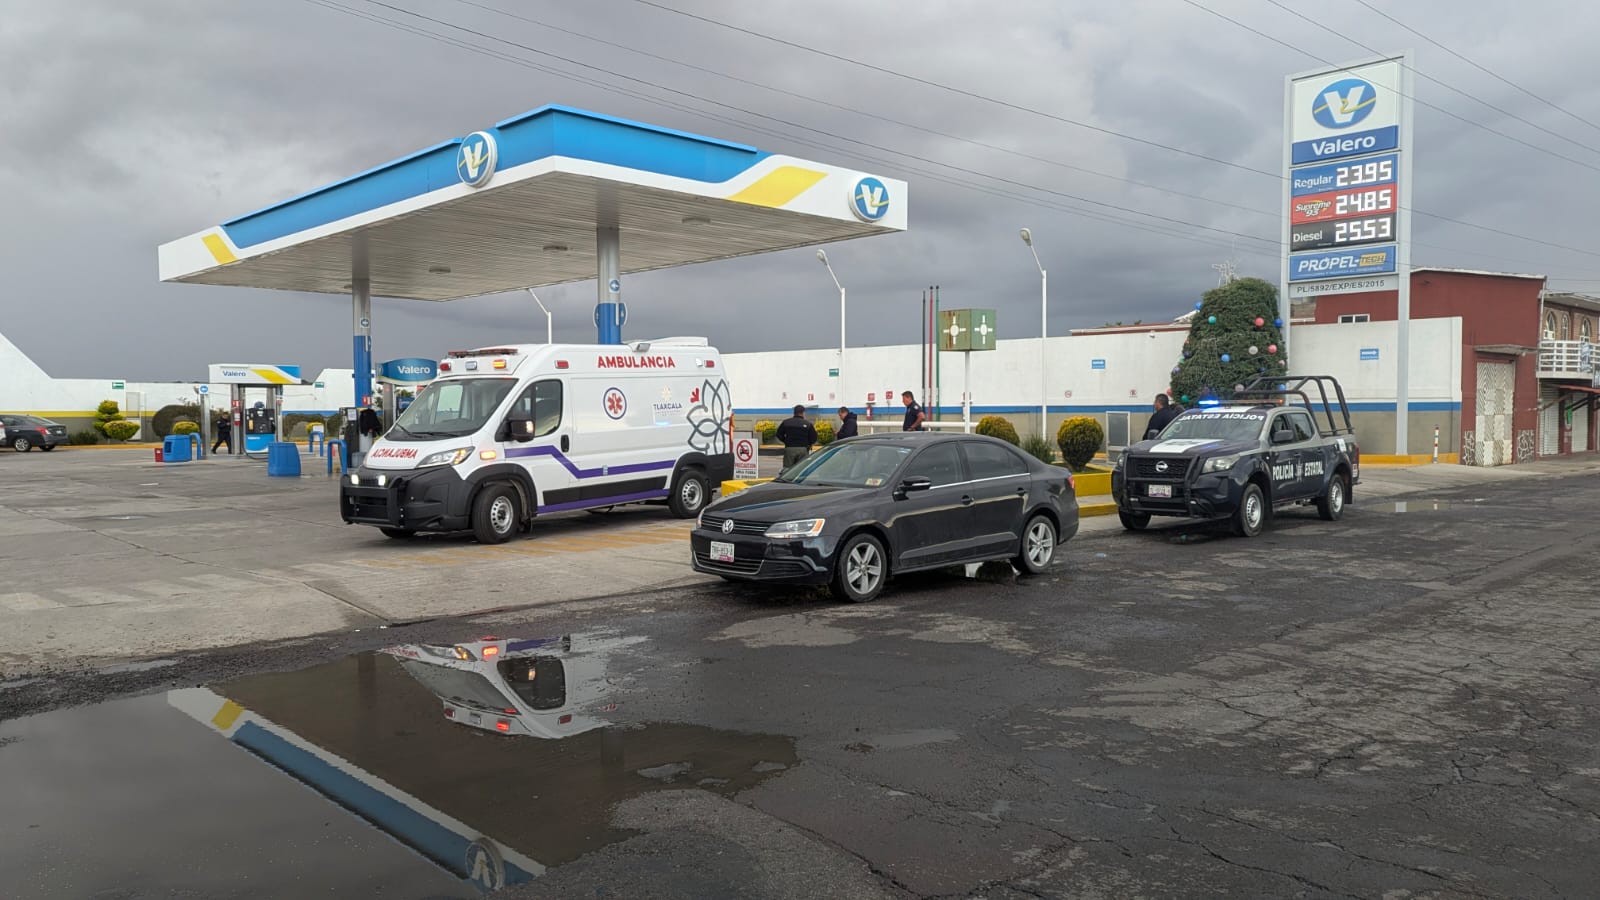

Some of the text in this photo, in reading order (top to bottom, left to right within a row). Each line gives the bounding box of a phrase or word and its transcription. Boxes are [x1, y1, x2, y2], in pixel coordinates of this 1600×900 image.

[1312, 136, 1376, 156] Valero
[1294, 175, 1333, 188] Regular
[1296, 200, 1331, 213] Supreme
[1306, 209, 1320, 217] 93
[1293, 230, 1323, 242] Diesel
[1297, 280, 1385, 293] PL/5892/EXP/ES/2015
[597, 356, 676, 368] AMBULANCIA
[397, 365, 431, 374] Valero
[653, 403, 682, 411] TLAXCALA
[1304, 461, 1324, 477] ESTATAL
